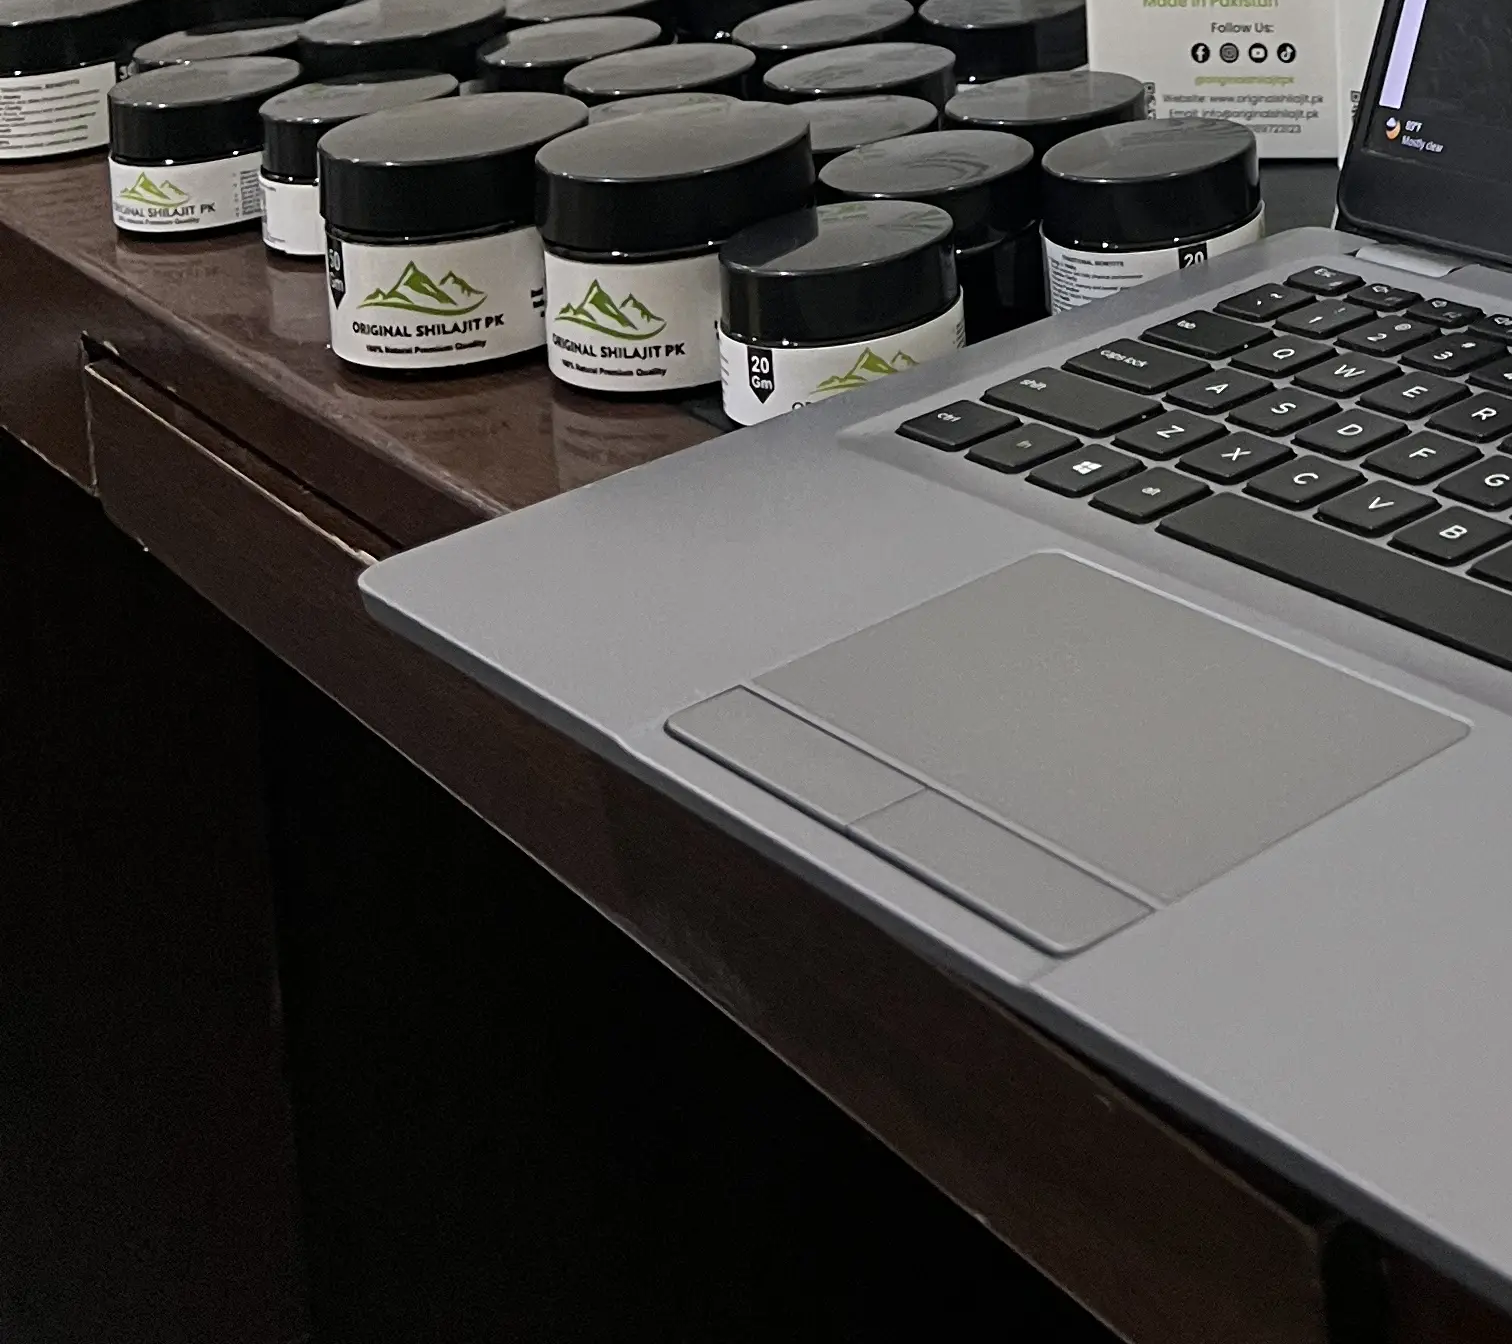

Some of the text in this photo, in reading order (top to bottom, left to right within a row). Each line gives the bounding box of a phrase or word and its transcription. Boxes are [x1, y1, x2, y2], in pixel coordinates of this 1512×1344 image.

[1209, 21, 1274, 34] Follow Us:
[352, 313, 505, 338] ORIGINAL SHILAJIT PK
[552, 333, 686, 360] ORIGINAL SHILAJIT PK
[751, 355, 770, 375] 20
[1334, 364, 1366, 378] W
[751, 374, 774, 390] Gm
[1205, 383, 1229, 394] A
[1402, 385, 1428, 398] E
[1271, 402, 1297, 414] S
